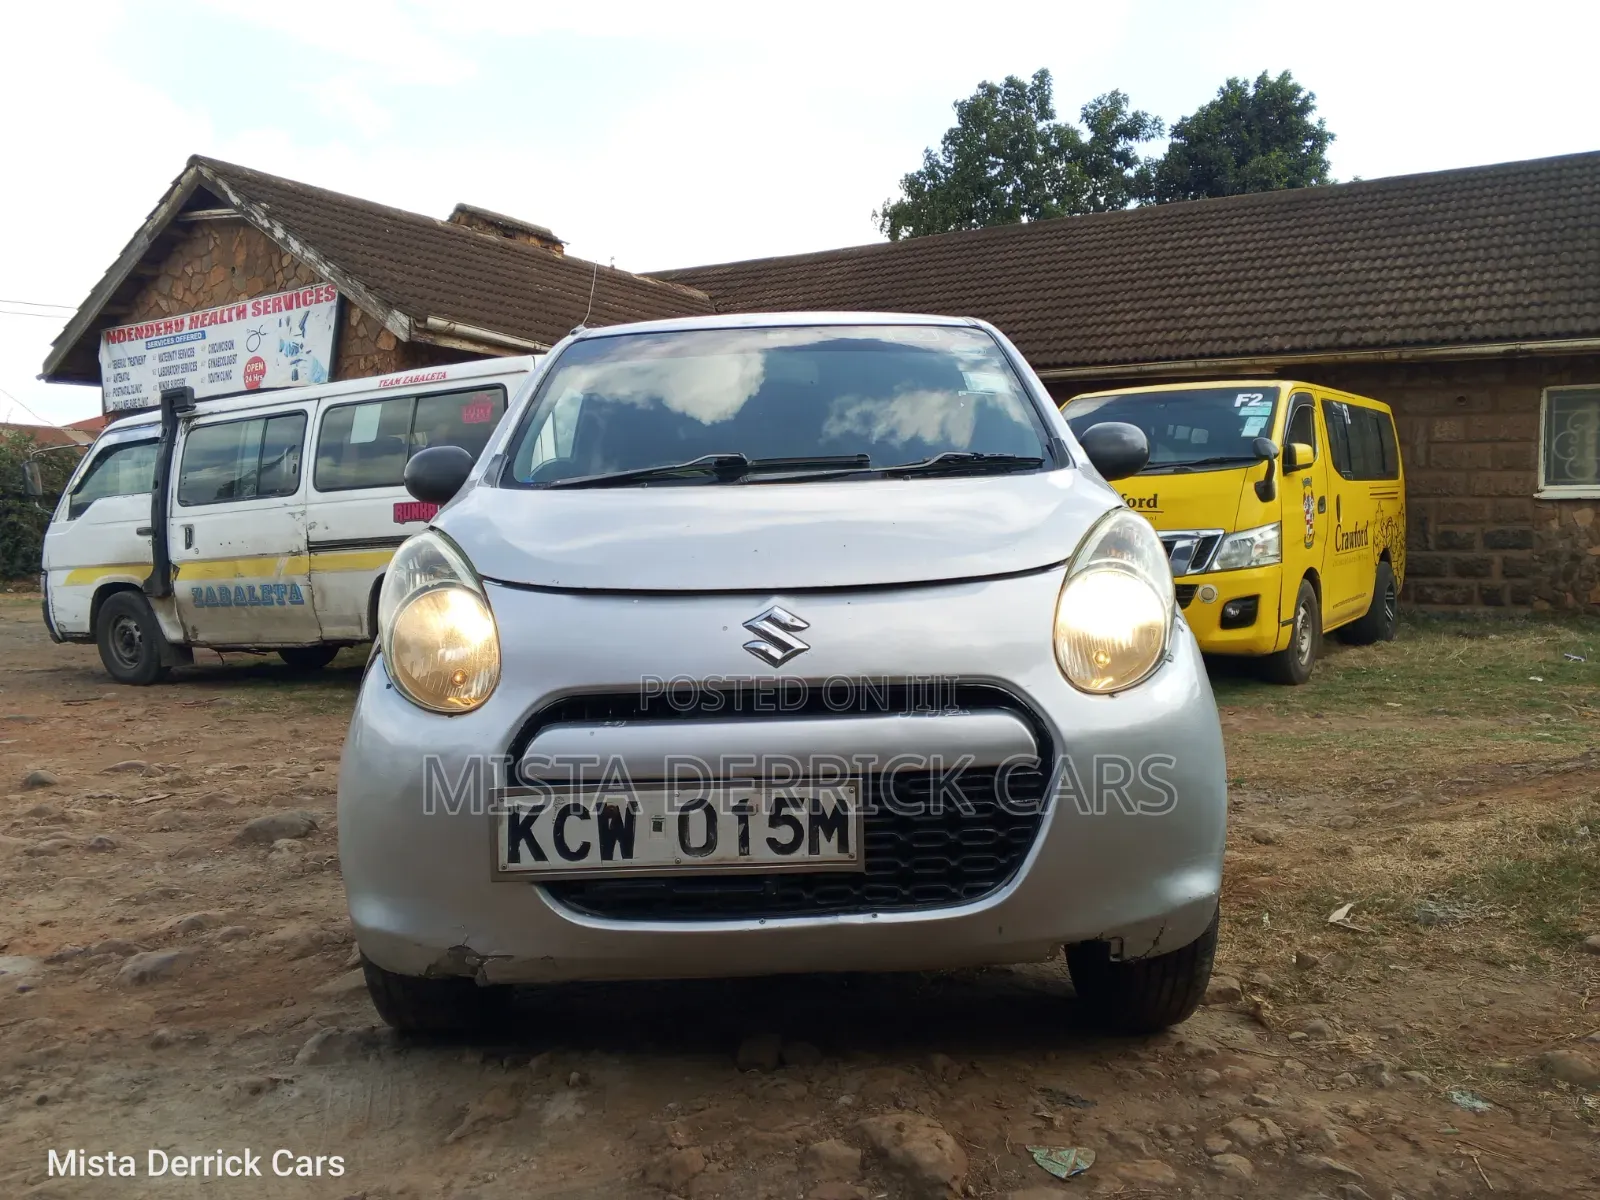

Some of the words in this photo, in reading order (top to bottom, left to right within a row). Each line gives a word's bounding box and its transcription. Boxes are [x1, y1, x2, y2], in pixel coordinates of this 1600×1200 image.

[188, 303, 247, 330] HEALTH
[251, 284, 337, 317] SERVICES
[147, 338, 174, 348] SERVICES
[175, 332, 202, 342] OFFERED
[178, 347, 195, 359] SERVICES
[158, 364, 180, 377] LABORATORY
[181, 361, 197, 374] SERVICES
[246, 362, 264, 373] OPEN
[245, 375, 252, 383] 24
[253, 374, 264, 382] Hrs
[379, 377, 401, 388] TEAM
[402, 371, 447, 384] ZABALETA
[1234, 393, 1263, 408] F2
[1335, 520, 1369, 552] Crawford
[191, 582, 305, 608] ZABALETA
[506, 801, 634, 864] KCW
[677, 796, 850, 857] 015M
